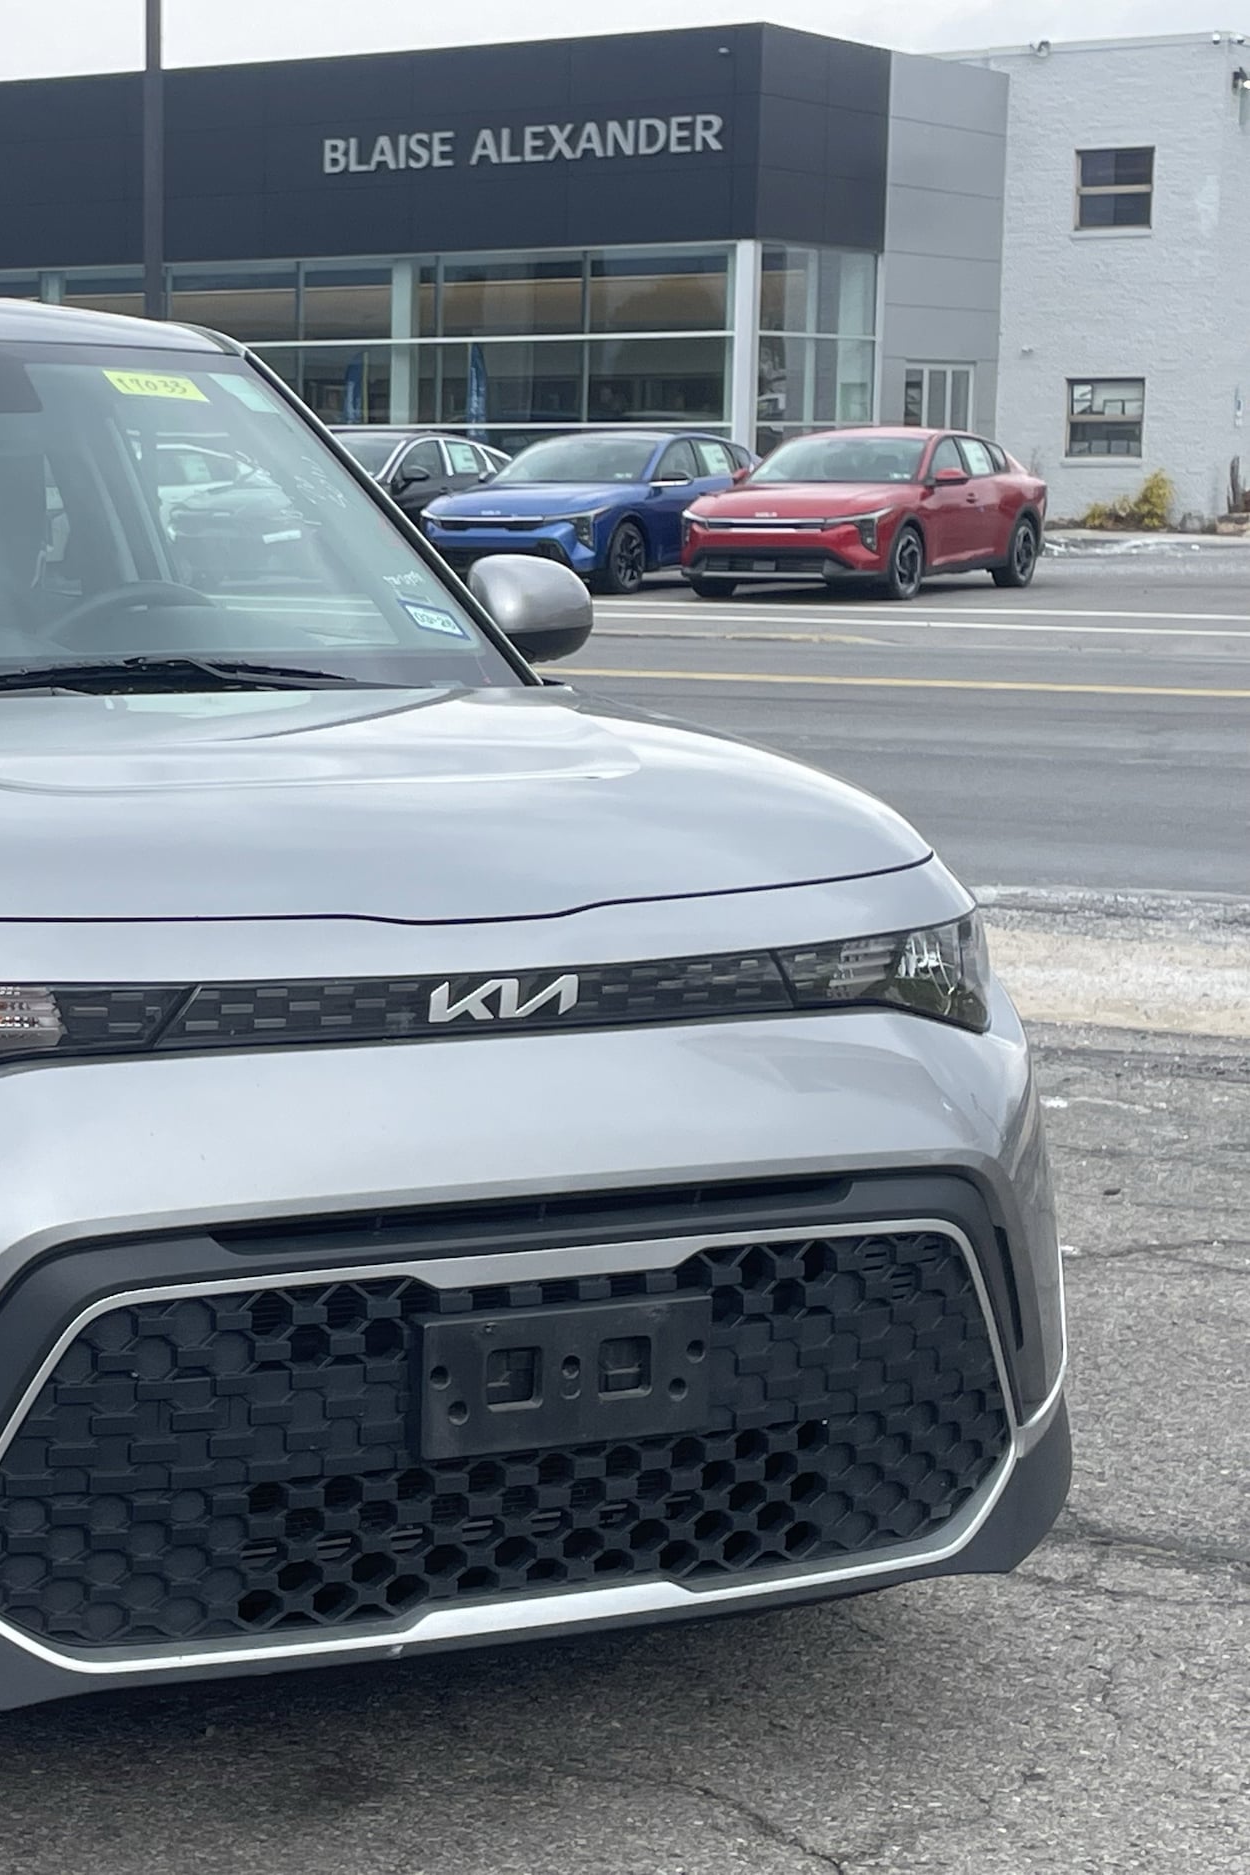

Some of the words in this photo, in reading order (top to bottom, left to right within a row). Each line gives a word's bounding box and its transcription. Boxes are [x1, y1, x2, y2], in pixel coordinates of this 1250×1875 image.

[323, 131, 454, 174] BLAISE
[470, 114, 723, 165] ALEXANDER
[429, 974, 579, 1023] KIA
